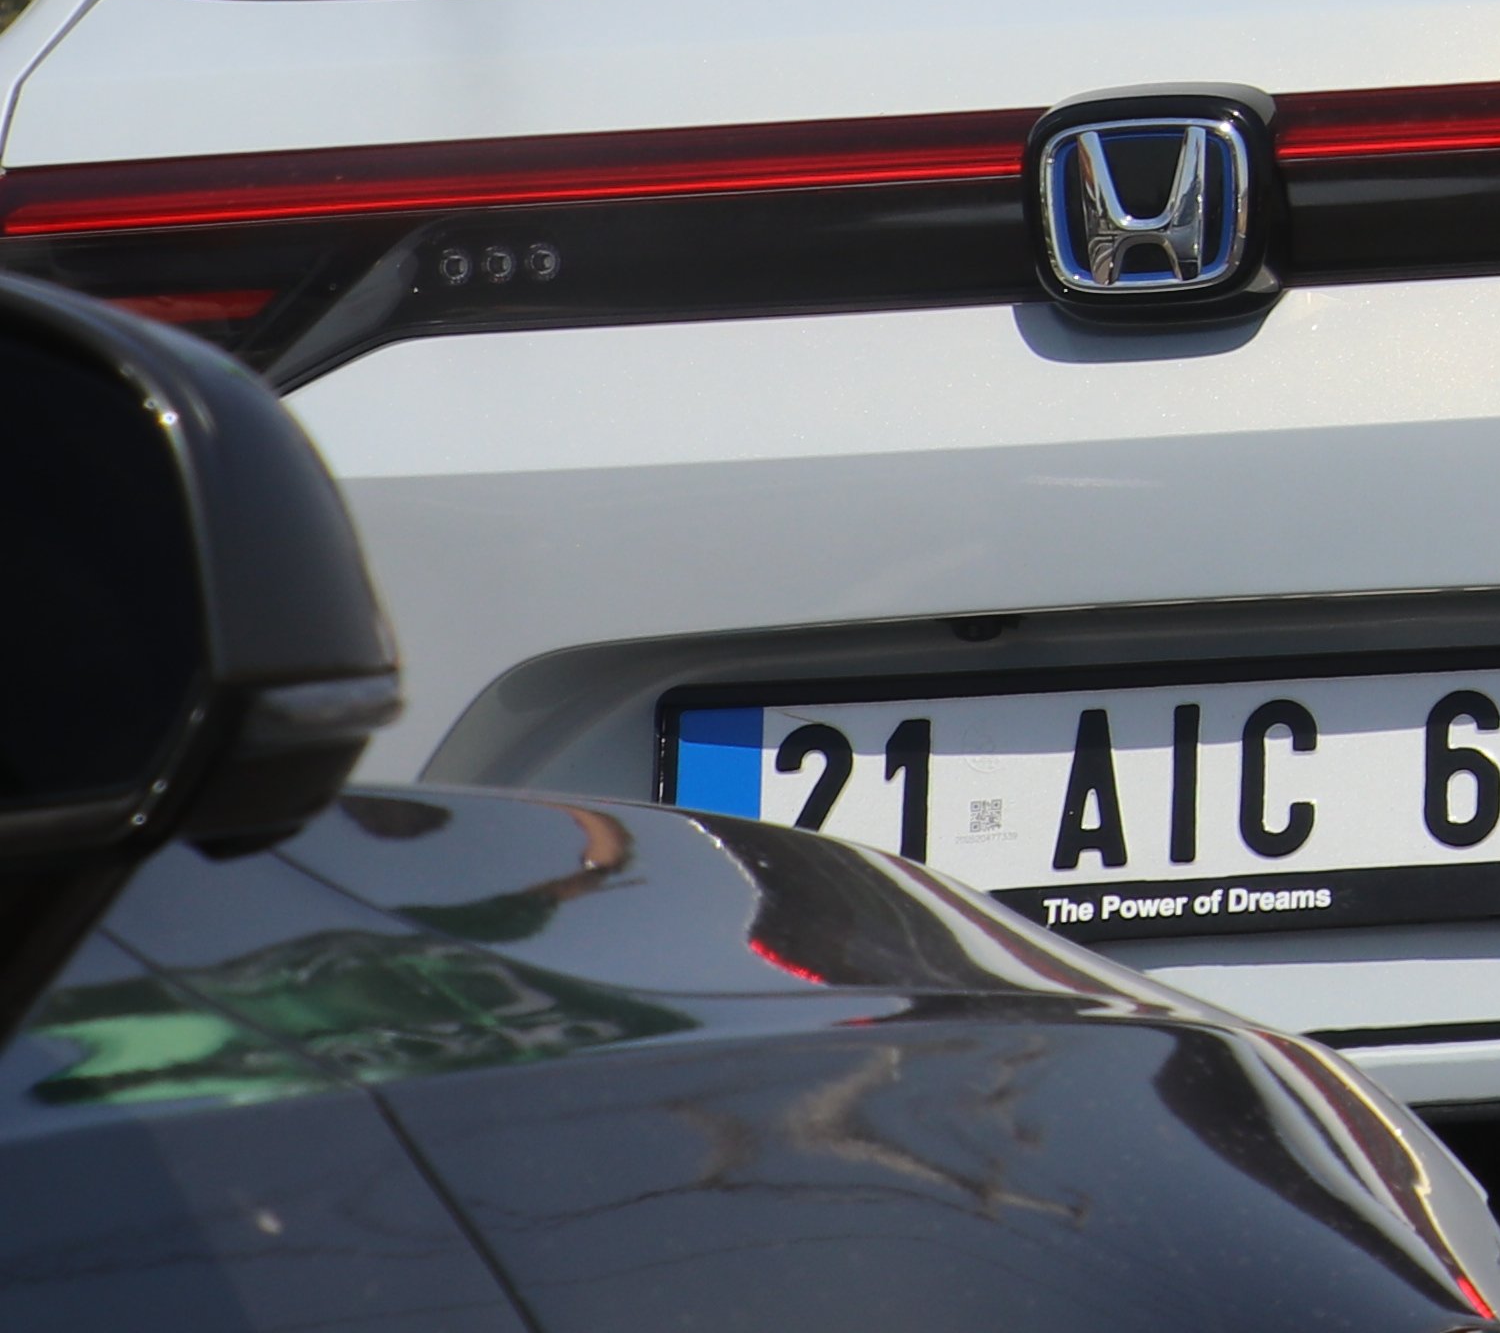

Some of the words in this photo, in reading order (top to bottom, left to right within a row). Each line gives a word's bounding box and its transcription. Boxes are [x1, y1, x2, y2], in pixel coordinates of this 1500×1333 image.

[776, 719, 931, 865] 21
[1053, 699, 1318, 869] AIC
[1043, 898, 1094, 924] The
[1101, 894, 1188, 920] Power
[1193, 889, 1224, 915] of
[1227, 887, 1331, 913] Dreams
